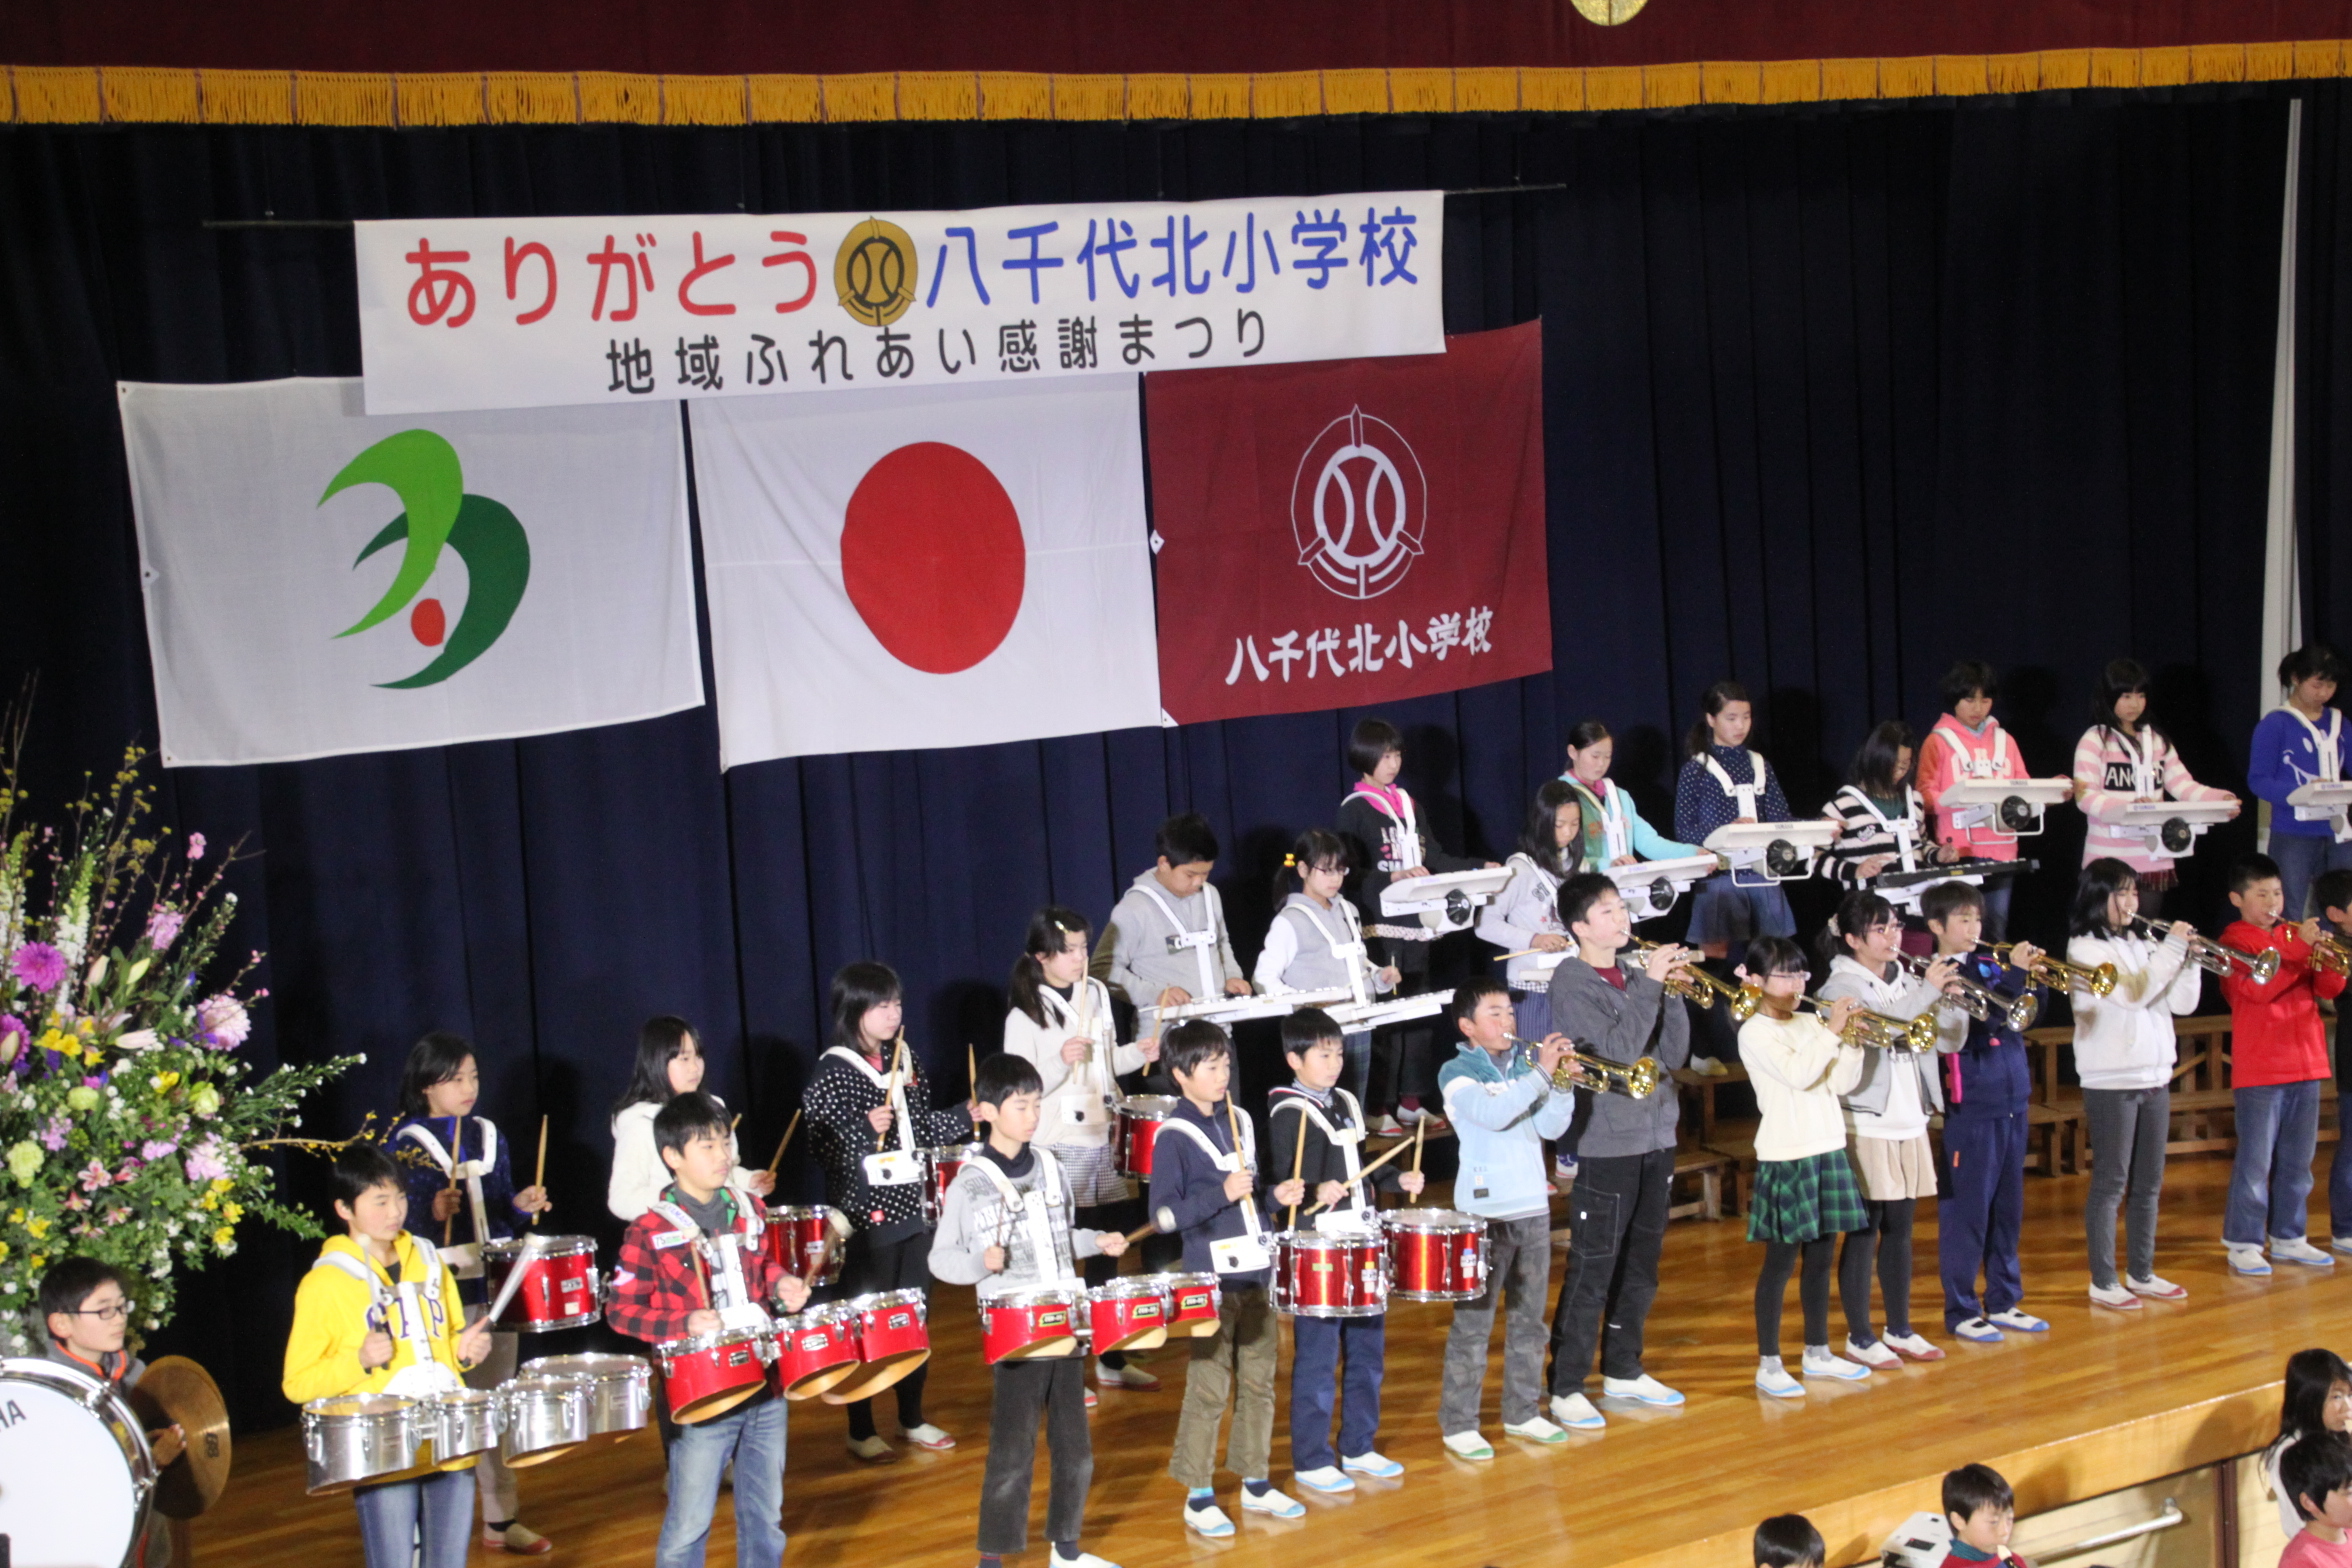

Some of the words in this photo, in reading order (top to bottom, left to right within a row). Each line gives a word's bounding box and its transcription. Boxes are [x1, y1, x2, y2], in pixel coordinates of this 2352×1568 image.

[405, 230, 818, 329] ありがとう
[926, 206, 1419, 308] 八千代北小学校
[605, 308, 1265, 395] 地域ふれあい感謝まつり
[1225, 605, 1494, 686] 八千代北小学校
